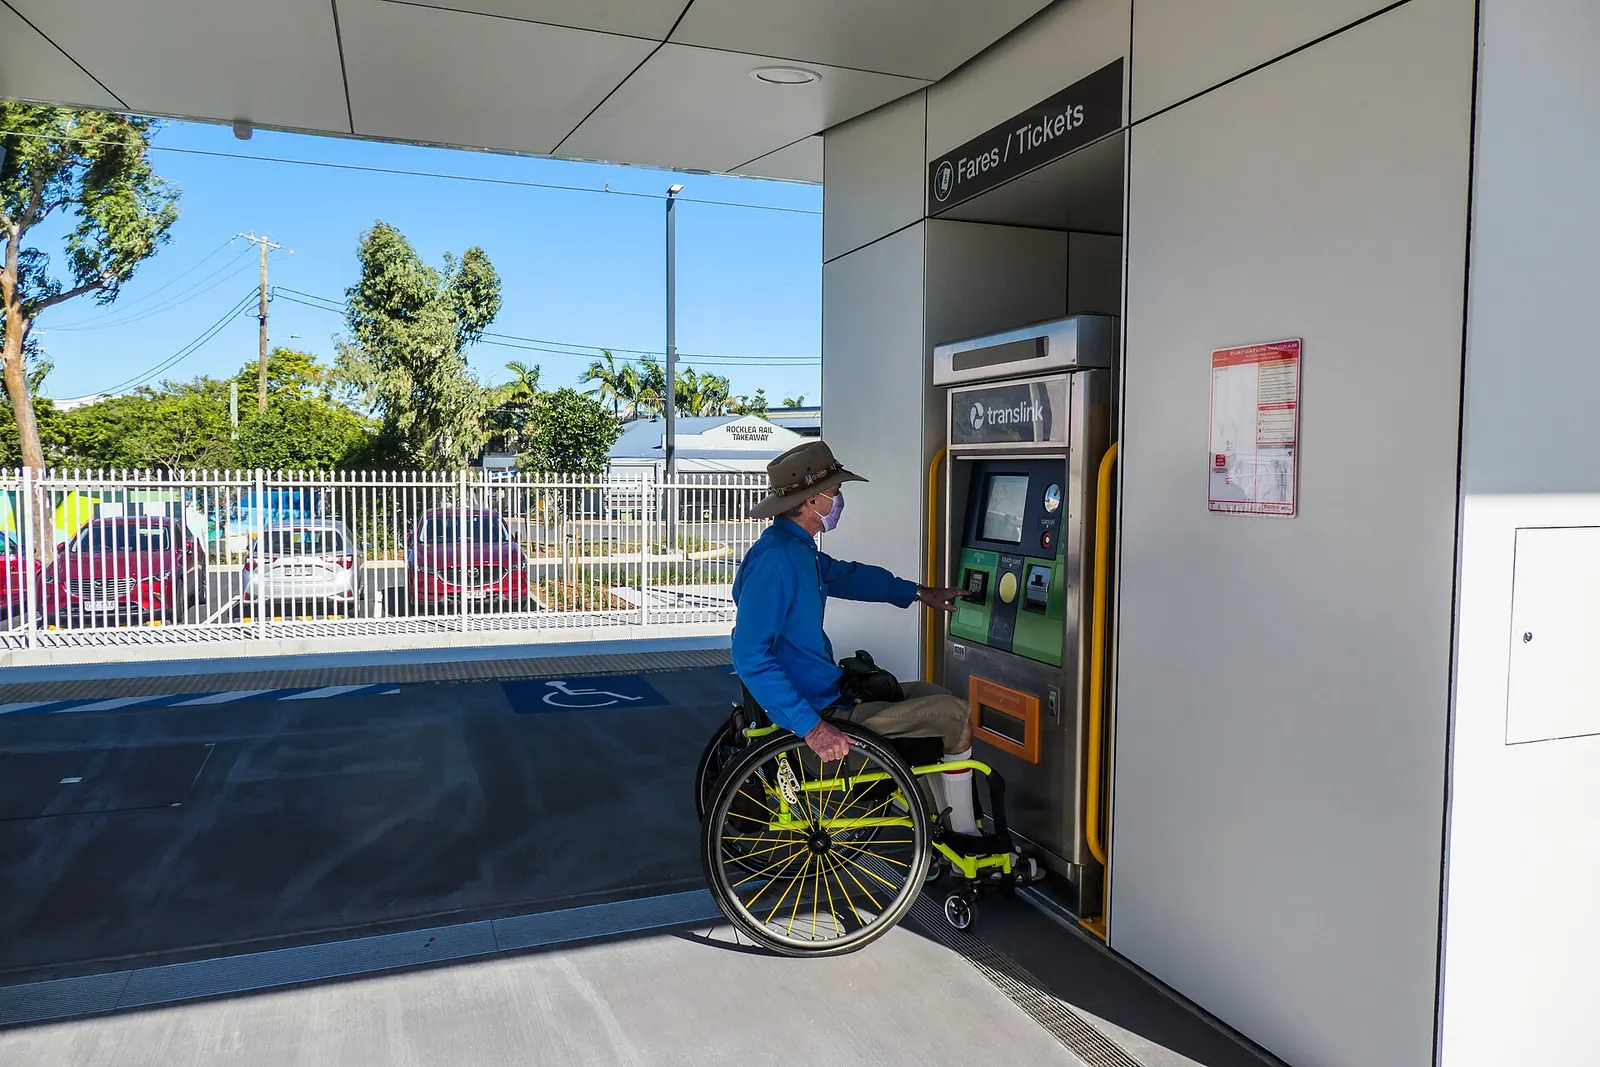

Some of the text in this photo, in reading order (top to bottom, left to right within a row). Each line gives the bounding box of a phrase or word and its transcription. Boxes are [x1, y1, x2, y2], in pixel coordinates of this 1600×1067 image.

[958, 104, 1084, 184] Fares / Tickets
[1229, 347, 1267, 357] EVACUATION
[1268, 343, 1297, 351] DIAGRAM
[987, 400, 1044, 424] translink
[758, 426, 774, 434] RAIL
